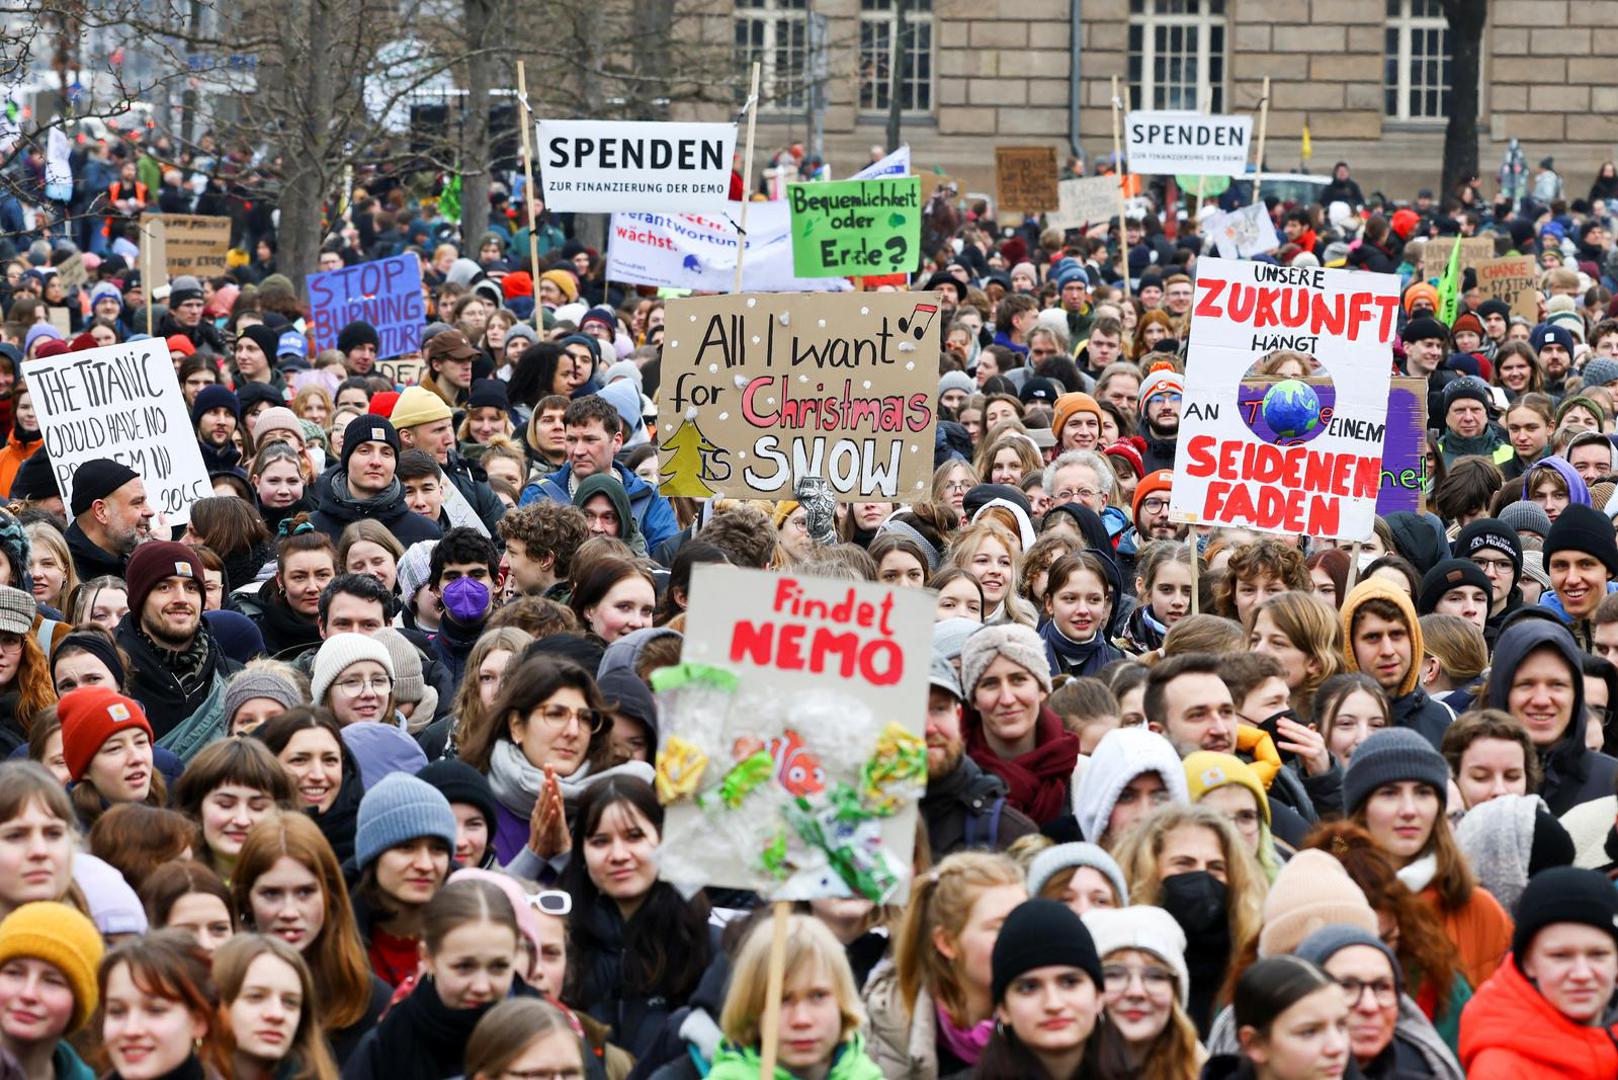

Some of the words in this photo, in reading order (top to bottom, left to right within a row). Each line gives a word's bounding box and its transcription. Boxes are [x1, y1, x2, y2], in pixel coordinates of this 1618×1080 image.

[1132, 124, 1243, 146] SPENDEN
[549, 137, 723, 170] SPENDEN
[549, 181, 572, 191] ZUR
[576, 182, 663, 193] FINANZIERUNG
[666, 183, 688, 193] DER
[692, 183, 725, 194] DEMO
[793, 181, 917, 217] Bequemlichkeit
[831, 209, 875, 230] oder
[616, 225, 678, 252] wächst.
[820, 236, 908, 272] Erde?
[311, 260, 404, 308] STOP
[1255, 265, 1325, 290] UNSERE
[1482, 262, 1527, 279] CHANGE
[1491, 278, 1535, 291] SYSTEM
[1194, 278, 1402, 343] ZUKUNFT
[694, 314, 745, 368] All
[767, 314, 773, 367] I
[792, 317, 895, 368] want
[1252, 333, 1319, 354] HÄNGT
[28, 367, 81, 416] THE
[670, 372, 725, 413] for
[741, 375, 931, 433] Christmas
[1183, 402, 1219, 421] AN
[46, 417, 105, 458] WOULD
[106, 409, 144, 445] HAVE
[144, 406, 167, 437] NO
[1328, 417, 1385, 443] EINEM
[150, 445, 172, 480] IN
[743, 435, 904, 497] SNOW
[1186, 435, 1382, 499] SEIDENEN
[1203, 481, 1340, 537] FADEN
[773, 577, 895, 636] Findet
[729, 619, 904, 686] NEMO
